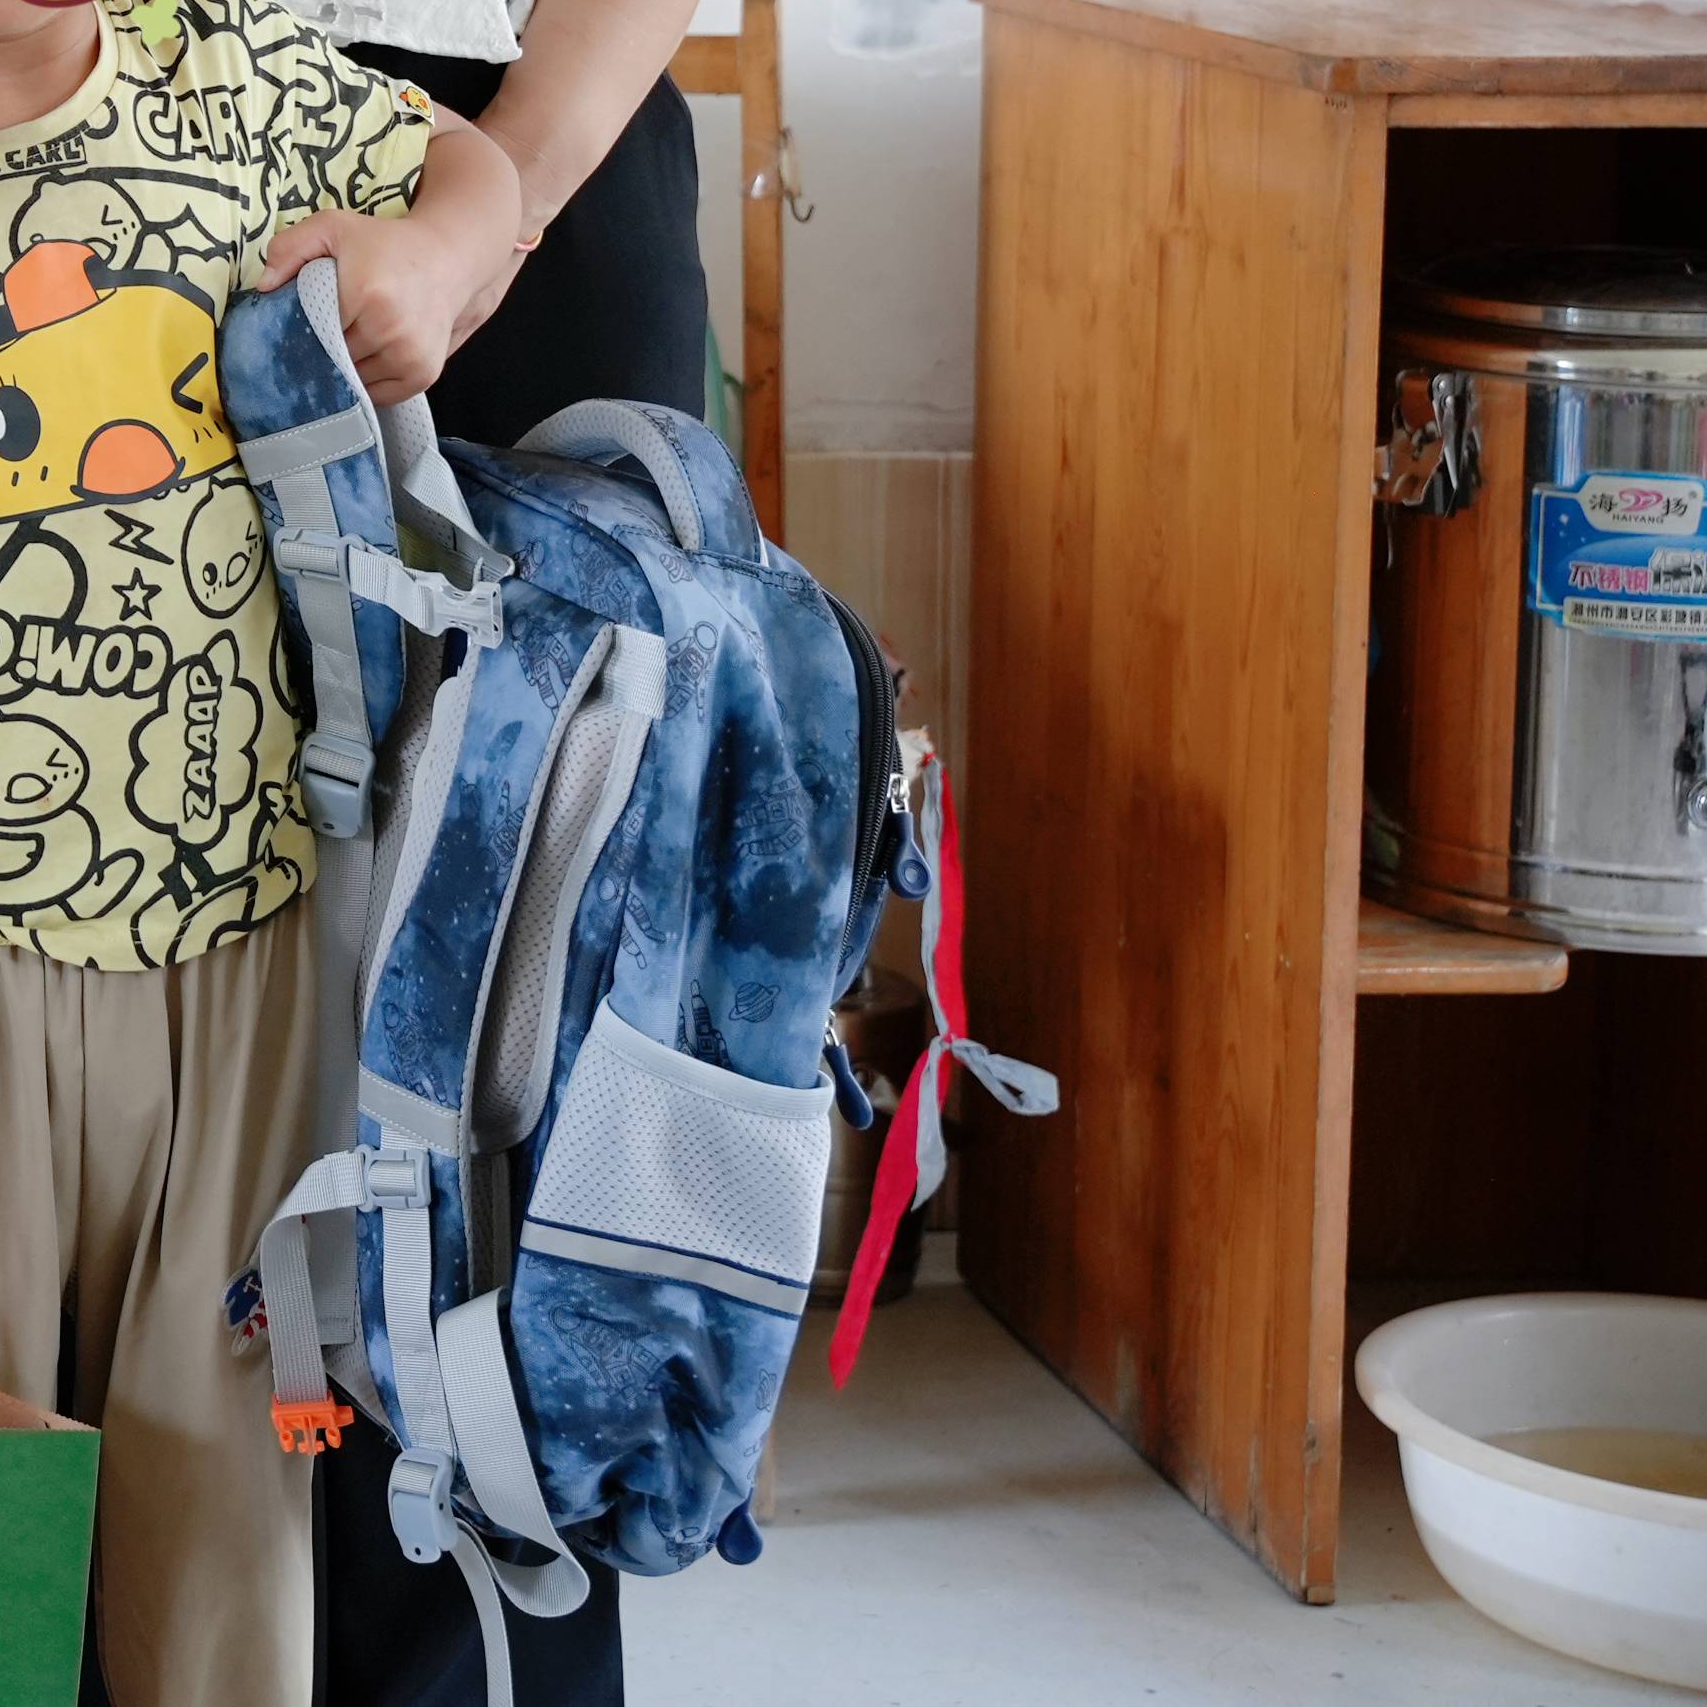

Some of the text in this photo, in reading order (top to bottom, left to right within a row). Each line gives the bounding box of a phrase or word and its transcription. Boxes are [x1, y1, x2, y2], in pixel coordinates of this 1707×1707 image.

[1589, 493, 1689, 517] 海 扬
[1612, 513, 1665, 525] HAIYANG
[184, 664, 218, 822] ZAAAP
